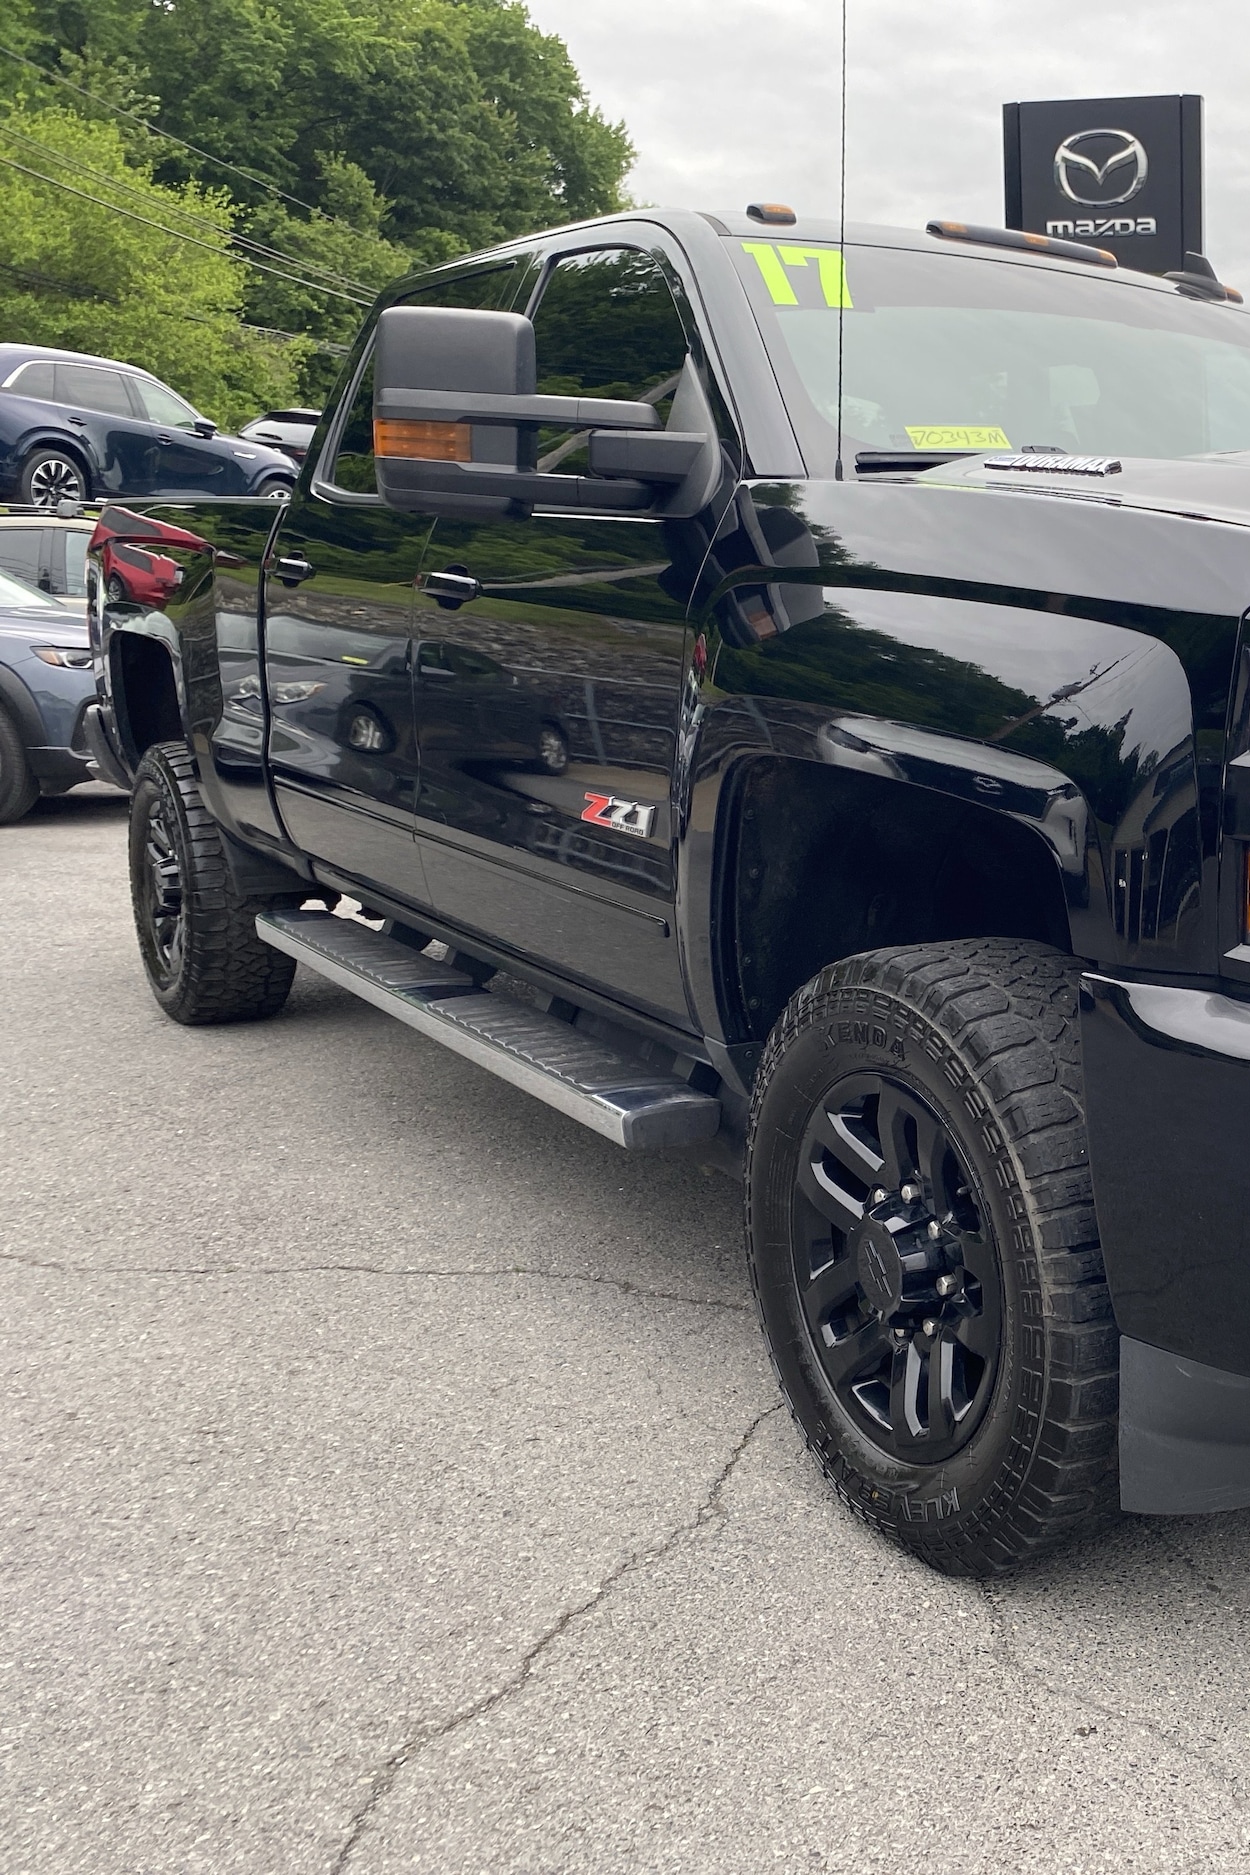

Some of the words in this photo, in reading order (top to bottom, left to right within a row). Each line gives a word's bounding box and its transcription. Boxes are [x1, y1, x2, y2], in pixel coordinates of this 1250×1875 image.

[741, 242, 854, 309] 17
[1010, 454, 1118, 474] DURAMAX
[581, 791, 656, 837] Z71
